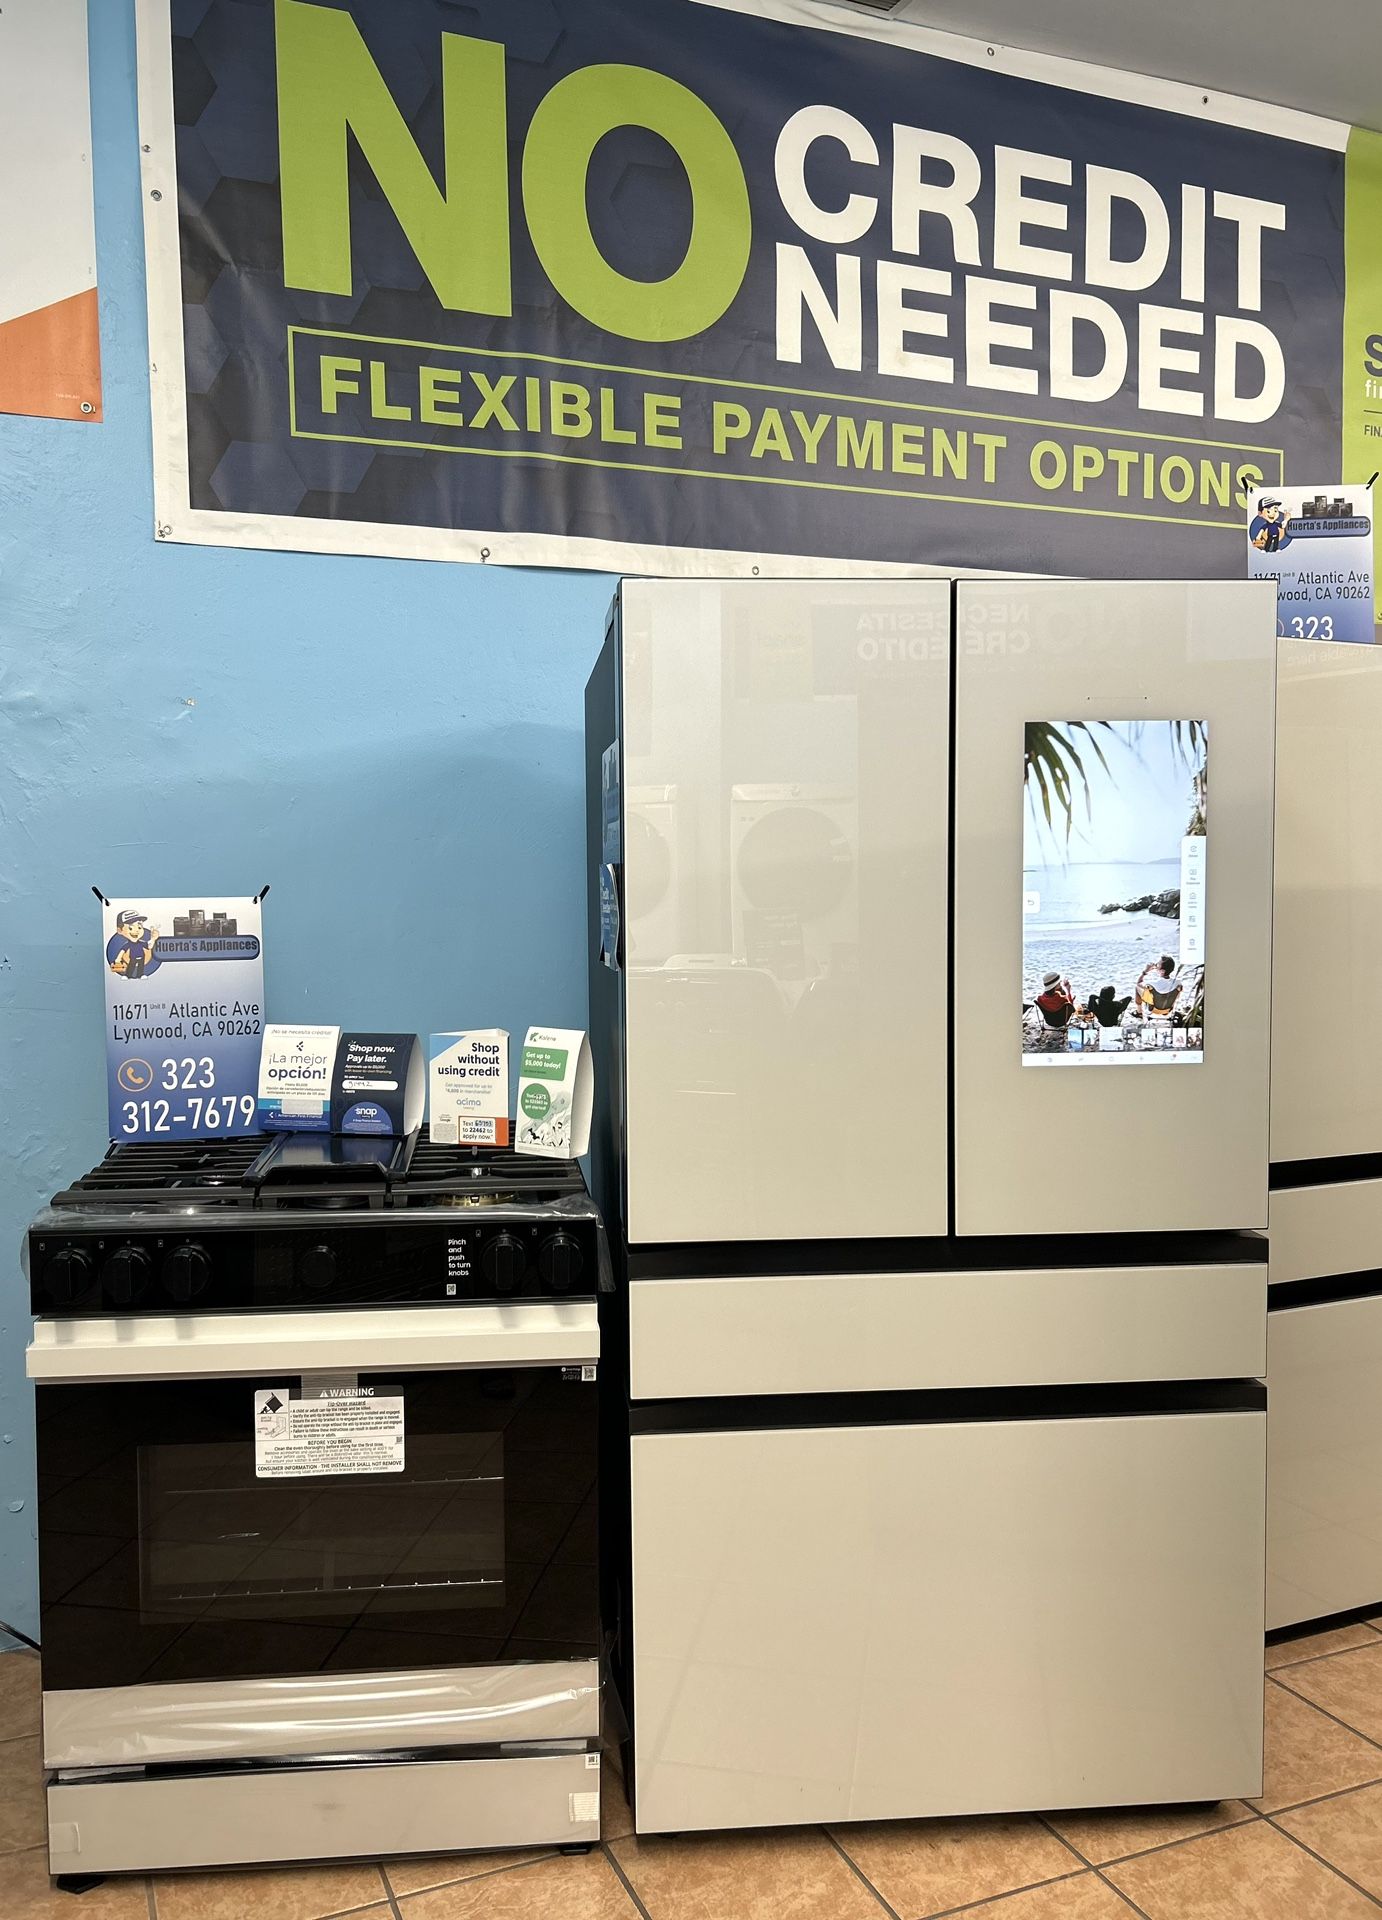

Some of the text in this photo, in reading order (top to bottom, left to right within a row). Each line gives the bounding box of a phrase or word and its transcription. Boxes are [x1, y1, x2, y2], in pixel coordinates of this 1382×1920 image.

[274, 0, 751, 342] NO
[775, 105, 1286, 311] CREDIT
[776, 242, 1286, 423] NEEDED
[320, 355, 1263, 508] FLEXIBLE PAYMENT OPTIONS
[1287, 519, 1369, 530] Huerta's Appliances
[1297, 571, 1344, 585] Atlantic
[1347, 570, 1369, 583] Ave
[1315, 587, 1332, 600] CA
[1336, 586, 1370, 600] 90262
[1291, 615, 1334, 640] 323
[155, 939, 257, 952] Huerta's Appliances
[113, 1004, 148, 1020] 11671
[169, 1002, 227, 1018] Atlantic
[232, 1001, 260, 1016] Ave
[113, 1020, 261, 1043] Lynwood, CA 90262
[349, 1044, 396, 1054] Shop now.
[472, 1043, 499, 1054] Shop
[290, 1054, 327, 1067] mejor
[346, 1054, 387, 1064] Pay later.
[458, 1054, 499, 1065] without
[543, 1060, 561, 1070] today!
[161, 1057, 215, 1091] 323
[268, 1066, 327, 1081] opción!
[438, 1066, 466, 1077] using
[456, 1097, 481, 1106] acima
[122, 1094, 256, 1134] 312-7679
[356, 1107, 377, 1117] snap
[448, 1254, 465, 1262] push
[329, 1387, 375, 1398] WARNING
